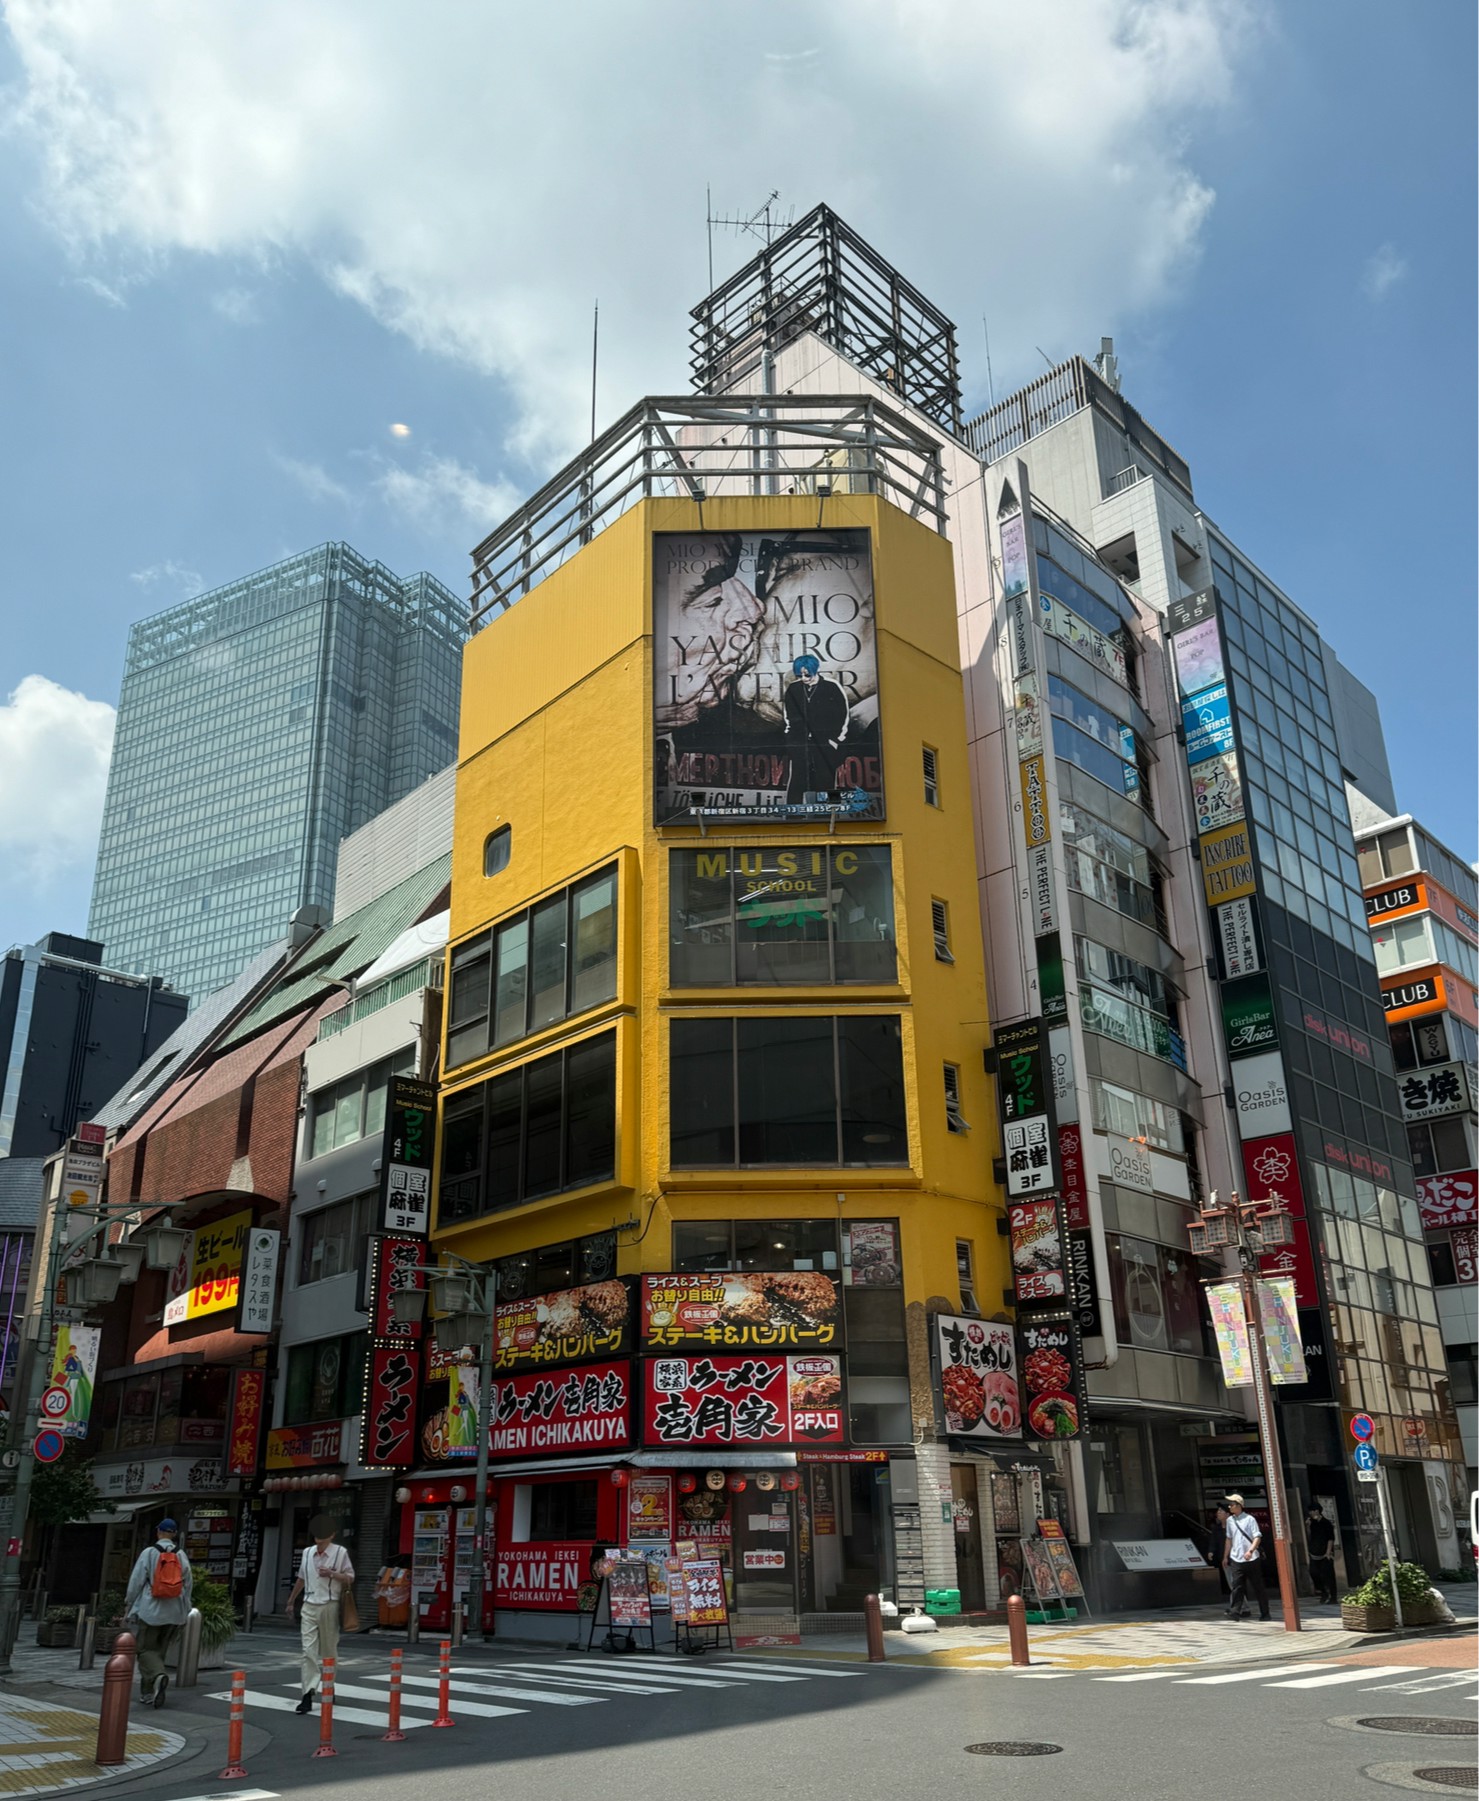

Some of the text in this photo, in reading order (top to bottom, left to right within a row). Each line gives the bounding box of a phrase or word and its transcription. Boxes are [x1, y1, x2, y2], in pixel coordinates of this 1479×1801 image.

[770, 593, 860, 625] MIO
[670, 631, 862, 666] YASHIRO
[1024, 761, 1045, 841] TATTOO
[696, 851, 859, 878] MUSIC
[746, 880, 818, 894] SCHOOL
[1036, 865, 1050, 907] PERFECT
[1365, 888, 1412, 915] CLUB
[1224, 919, 1239, 955] PERFECT
[1382, 983, 1429, 1010] CLUB
[1230, 1011, 1271, 1028] GirlsBar
[1000, 1044, 1039, 1060] Music School
[1425, 1025, 1440, 1057] WAGYU
[1010, 1055, 1036, 1115] ウッド
[1239, 1087, 1285, 1104] Oasis
[396, 1099, 433, 1112] Music School
[1004, 1094, 1014, 1116] 4F
[1416, 1104, 1462, 1119] SUKIYAKI
[404, 1108, 425, 1161] ウッド
[1008, 1123, 1047, 1150] 個室
[394, 1138, 402, 1157] 4F
[1010, 1145, 1049, 1172] 麻雀
[1111, 1148, 1151, 1175] Oasis
[391, 1170, 427, 1194] 個室
[1020, 1174, 1042, 1189] 3F
[388, 1191, 426, 1214] 麻雀
[396, 1215, 416, 1228] 3F
[1012, 1209, 1033, 1227] 2F
[195, 1224, 243, 1265] 生ビール
[647, 1275, 724, 1290] ライス&スープ
[1018, 1274, 1046, 1288] ライス
[1072, 1239, 1092, 1308] RINKAN
[248, 1256, 261, 1321] レタスや
[257, 1257, 273, 1322] 菜食酒場
[1019, 1284, 1057, 1299] &スープ
[495, 1299, 538, 1318] ライス&スープ
[648, 1324, 835, 1346] ステーキ&ハンバーグ
[1023, 1327, 1069, 1348] すためし
[1272, 1287, 1294, 1364] SHINJUKU
[494, 1327, 623, 1369] ステーキ&ハンバーグ
[941, 1321, 1011, 1370] すためし
[690, 1358, 784, 1392] ラーメン
[48, 1394, 66, 1411] 20
[373, 1354, 414, 1461] ラーメン
[231, 1373, 259, 1466] お好み焼
[655, 1393, 787, 1442] 壱角家
[794, 1414, 839, 1430] 2F入口
[312, 1427, 340, 1459] 百花
[531, 1418, 628, 1445] ICHIKAKUYA
[866, 1451, 879, 1461] 2F
[1360, 1450, 1370, 1467] P
[678, 1525, 731, 1537] RAMEN
[498, 1551, 580, 1561] YOKOHAMA IEKEI
[745, 1554, 775, 1565] 営業中
[496, 1562, 579, 1590] RAMEN
[687, 1578, 720, 1592] ライス
[509, 1591, 564, 1602] ICHIKAKUYA
[689, 1593, 722, 1609] 無料
